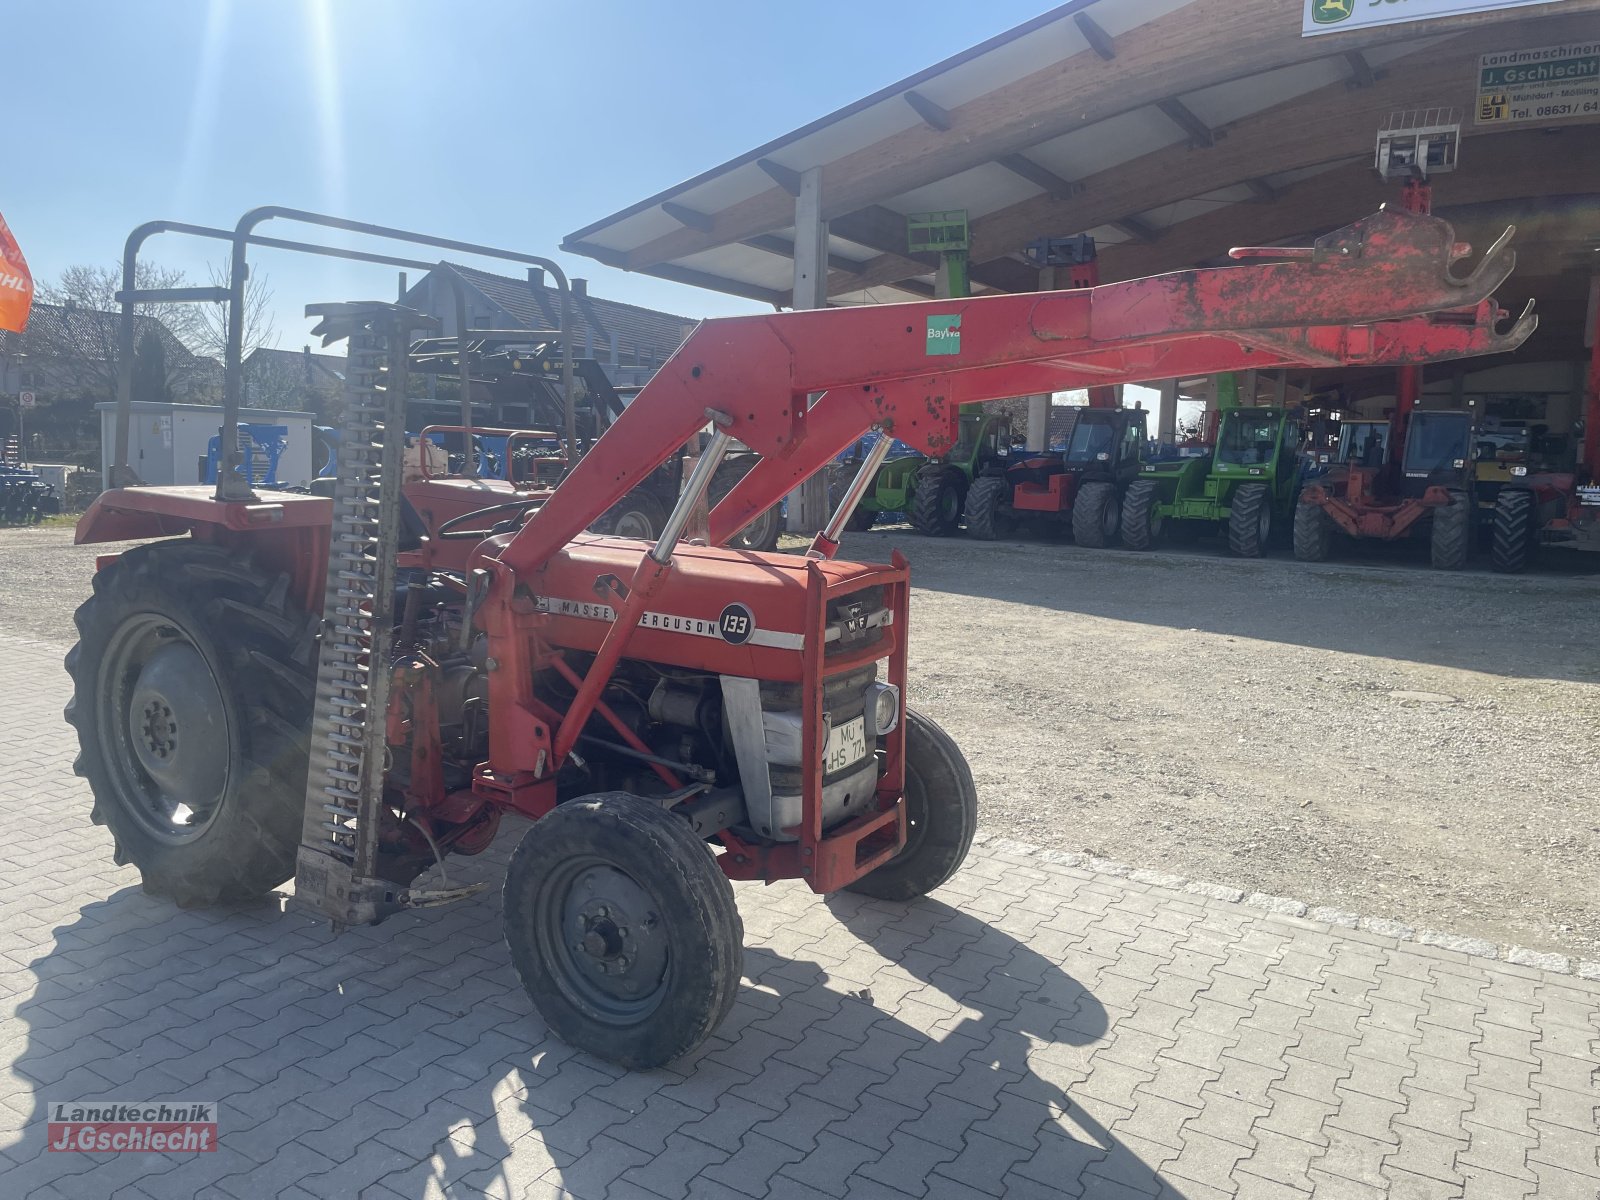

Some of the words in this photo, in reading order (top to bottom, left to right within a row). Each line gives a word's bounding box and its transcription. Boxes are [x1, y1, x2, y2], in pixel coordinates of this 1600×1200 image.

[1482, 44, 1600, 66] Landmaschinen
[1485, 71, 1499, 83] J.
[1504, 60, 1597, 82] Gschlecht
[1511, 108, 1532, 119] Tel.
[1536, 104, 1571, 116] 08631
[1583, 101, 1600, 112] 64
[641, 613, 716, 635] ERGUSON
[722, 614, 748, 634] 133
[840, 722, 855, 745] MÜ
[831, 748, 847, 770] HS
[852, 738, 862, 760] 77
